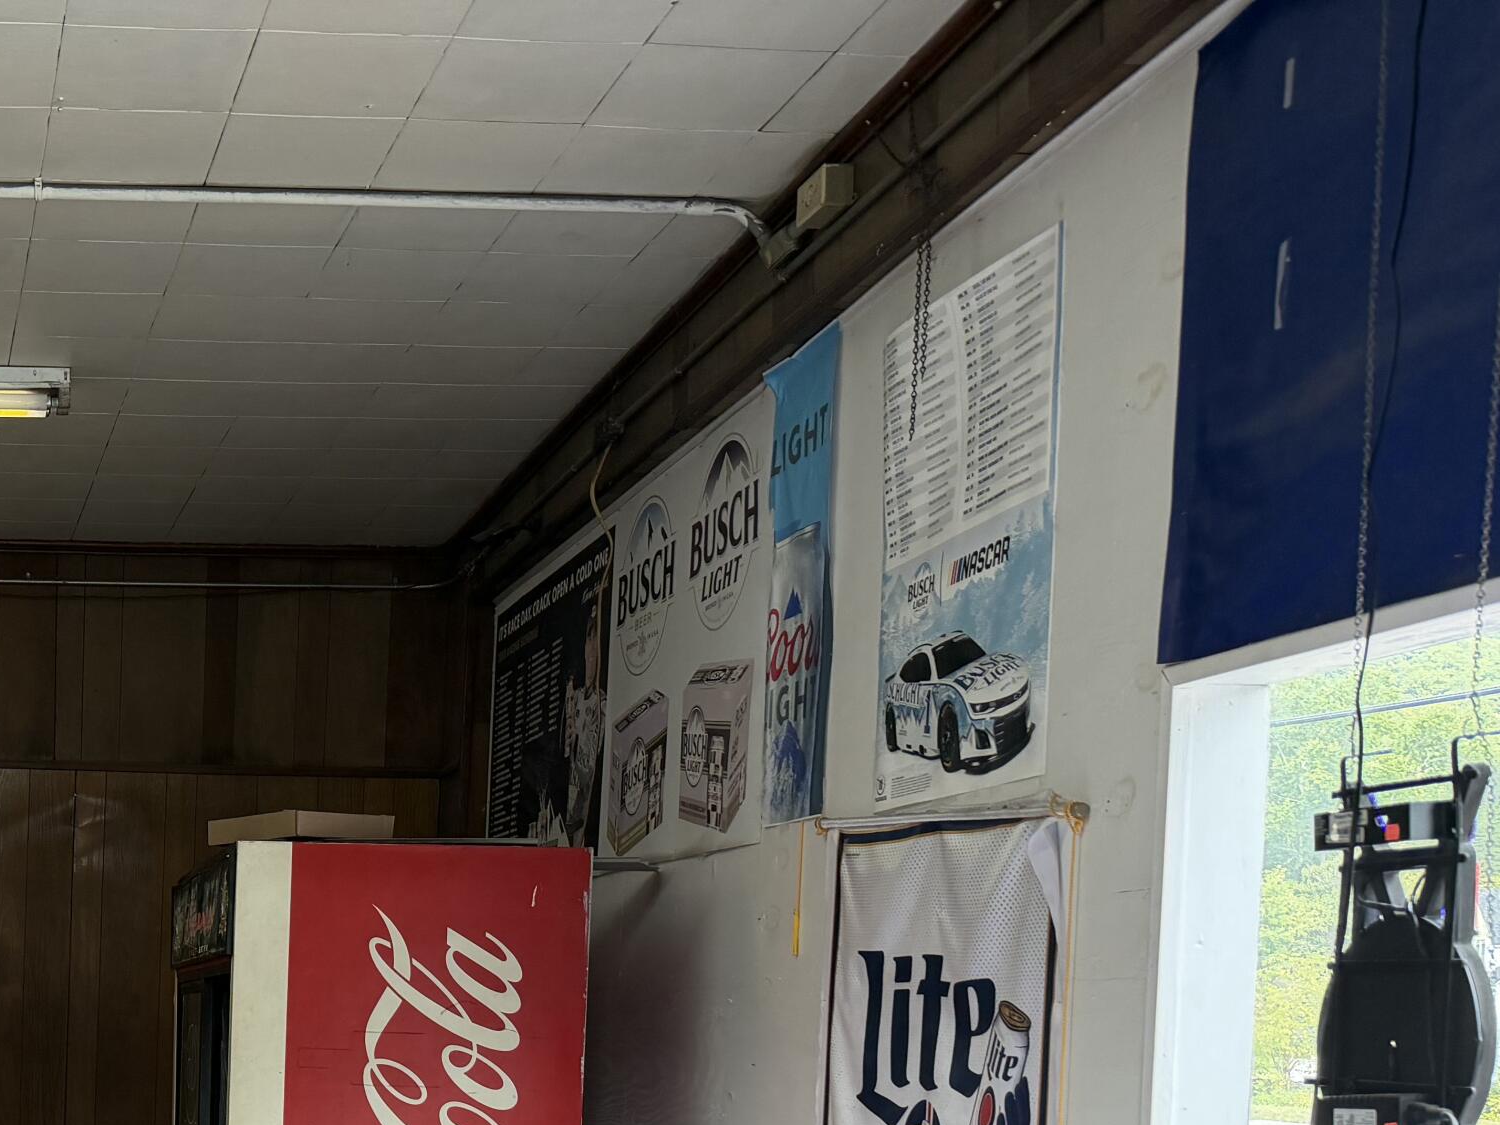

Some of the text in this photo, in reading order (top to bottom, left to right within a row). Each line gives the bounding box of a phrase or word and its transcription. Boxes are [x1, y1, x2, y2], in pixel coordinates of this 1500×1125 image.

[772, 404, 829, 479] LIGHT
[689, 478, 760, 580] BUSCH
[963, 535, 1011, 578] NASCAR
[532, 590, 552, 617] CRACK
[552, 578, 569, 603] OPEN
[576, 560, 593, 585] COLD
[617, 539, 678, 630] BUSCH
[701, 554, 743, 602] LIGHT
[907, 574, 936, 602] BUSCH
